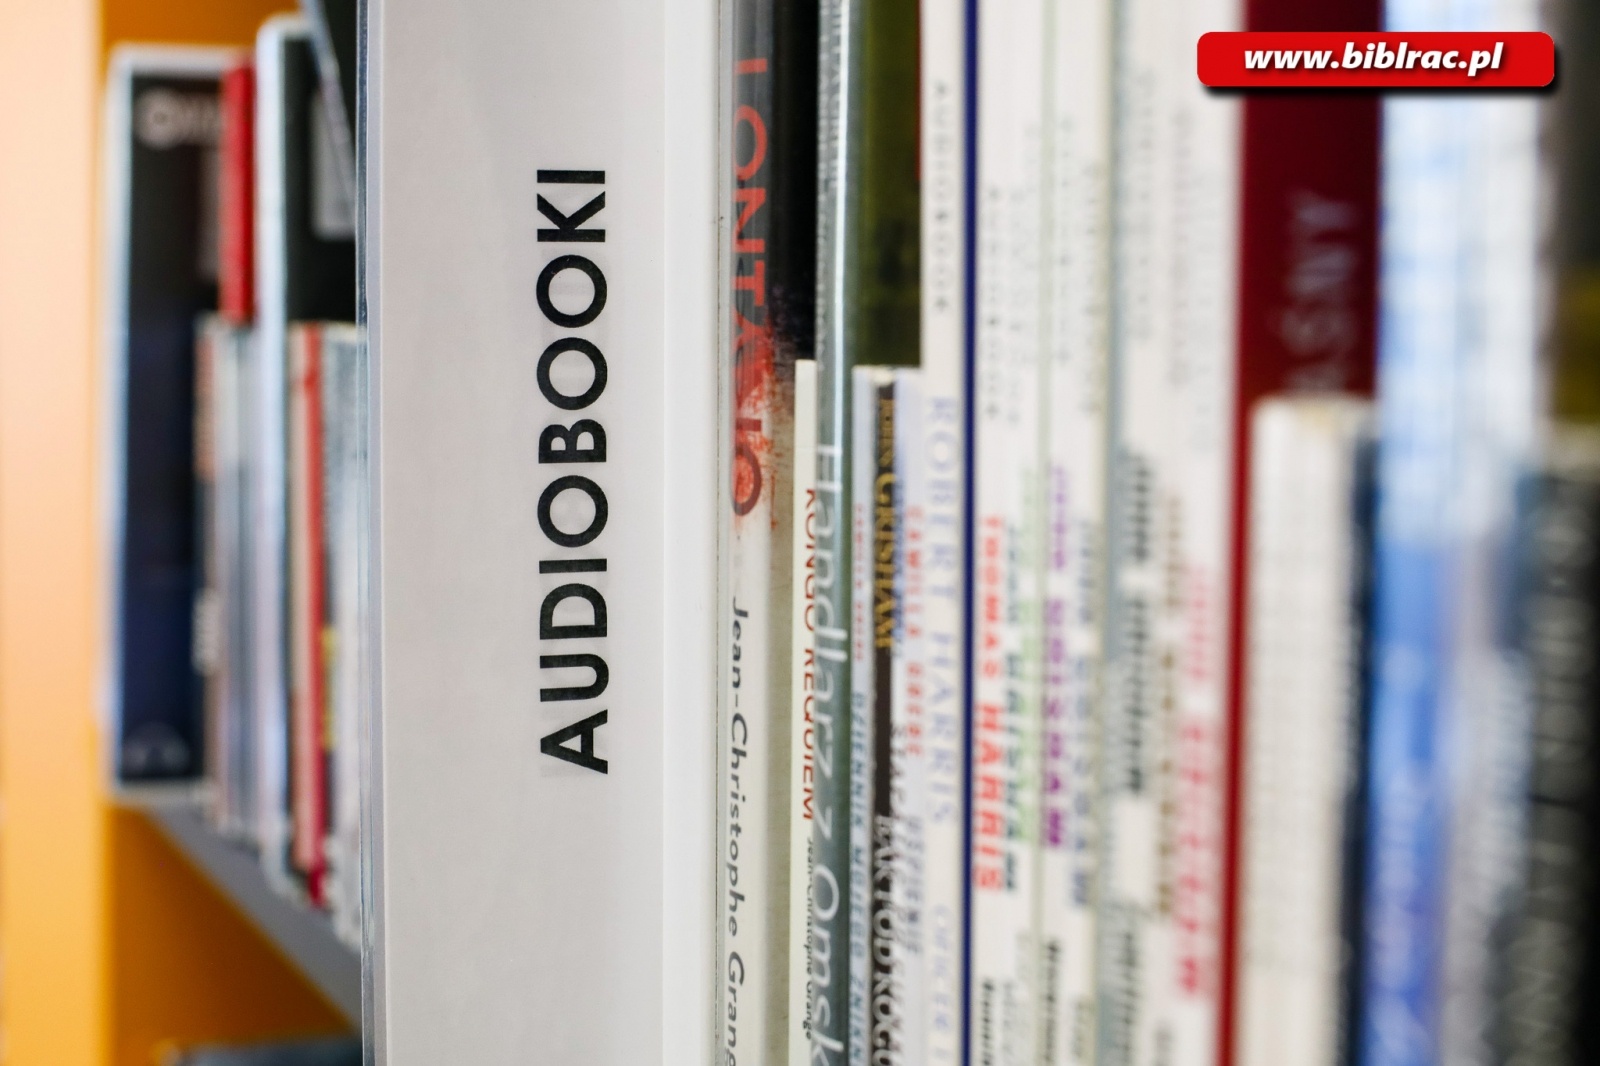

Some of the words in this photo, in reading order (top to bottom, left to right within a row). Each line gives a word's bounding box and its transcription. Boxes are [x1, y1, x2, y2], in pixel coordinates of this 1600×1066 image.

[536, 167, 609, 775] AUDIOBOOKI
[814, 444, 848, 780] Handlarz
[876, 473, 897, 648] GRISHAM
[727, 596, 750, 938] Jean-Christophe
[813, 806, 833, 840] z
